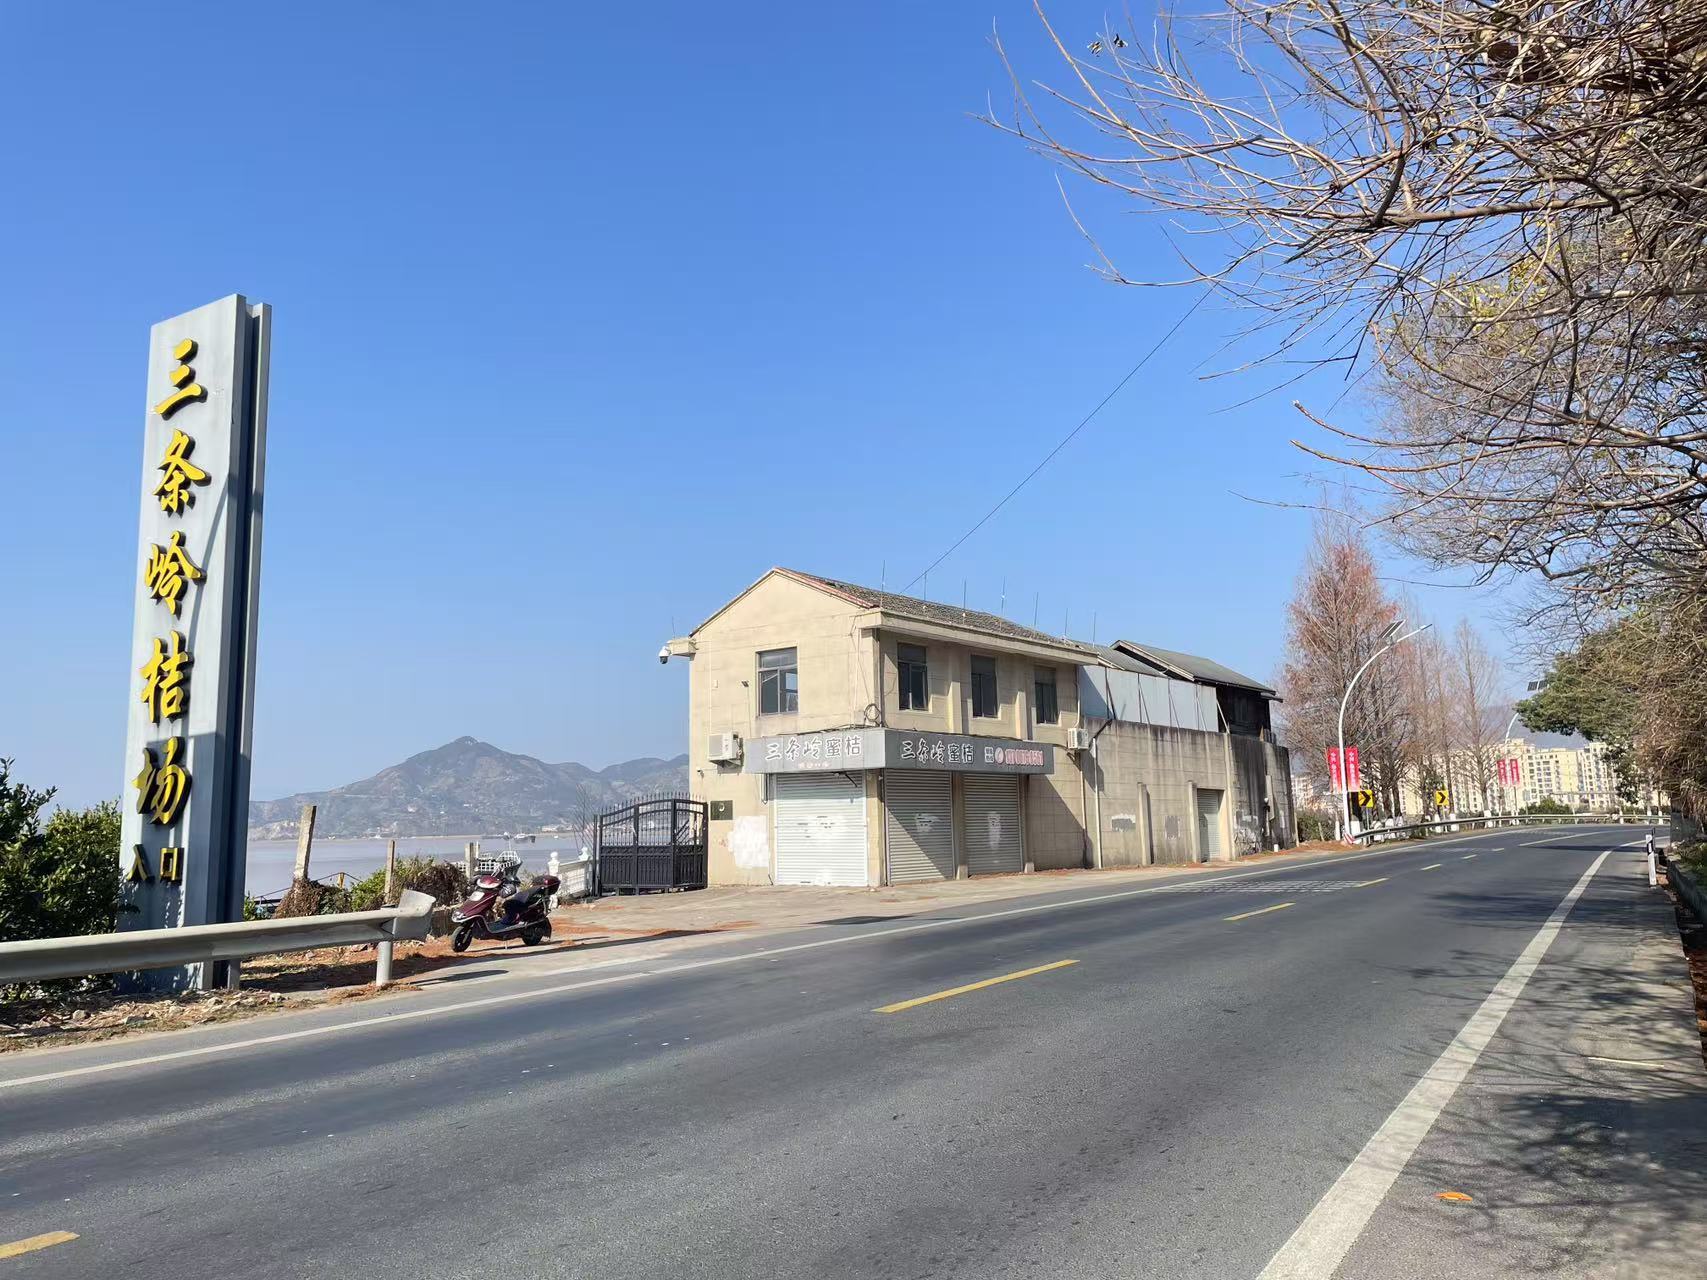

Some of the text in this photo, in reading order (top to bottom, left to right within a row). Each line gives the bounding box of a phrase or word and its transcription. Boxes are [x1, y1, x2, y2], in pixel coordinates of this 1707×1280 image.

[131, 338, 209, 826] 三条岭桔场
[764, 735, 863, 761] 三条岭蜜桔
[901, 738, 975, 764] 三条岭蜜桔
[126, 844, 184, 883] 入口
